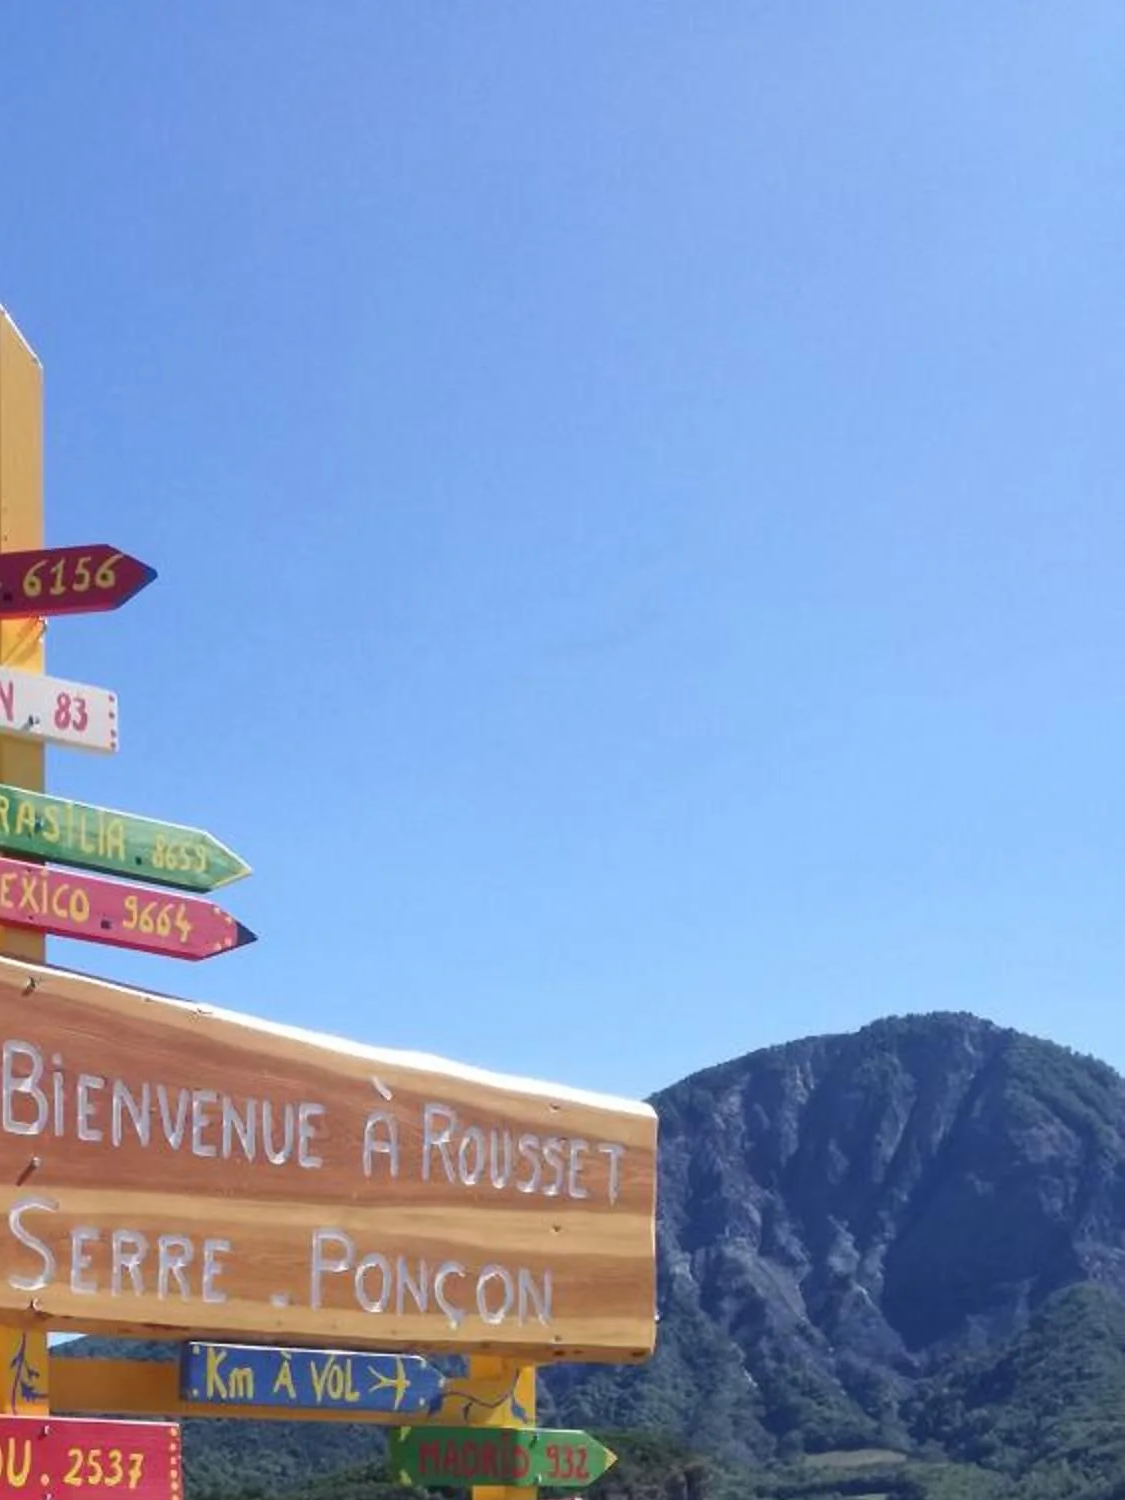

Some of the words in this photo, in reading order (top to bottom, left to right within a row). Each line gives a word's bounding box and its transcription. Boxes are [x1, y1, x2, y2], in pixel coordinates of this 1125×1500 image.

[23, 554, 122, 597] 6156
[54, 691, 88, 731] 83
[122, 895, 192, 943] 9664
[0, 1039, 325, 1169] BIENVENUE
[422, 1103, 626, 1206] ROUSSET
[7, 1195, 232, 1304] SERRE
[309, 1229, 554, 1330] PONÇON
[206, 1346, 254, 1400] Km
[310, 1354, 361, 1402] VOL
[63, 1448, 145, 1490] 2537
[417, 1433, 531, 1475] MADRID
[545, 1443, 590, 1481] 932
